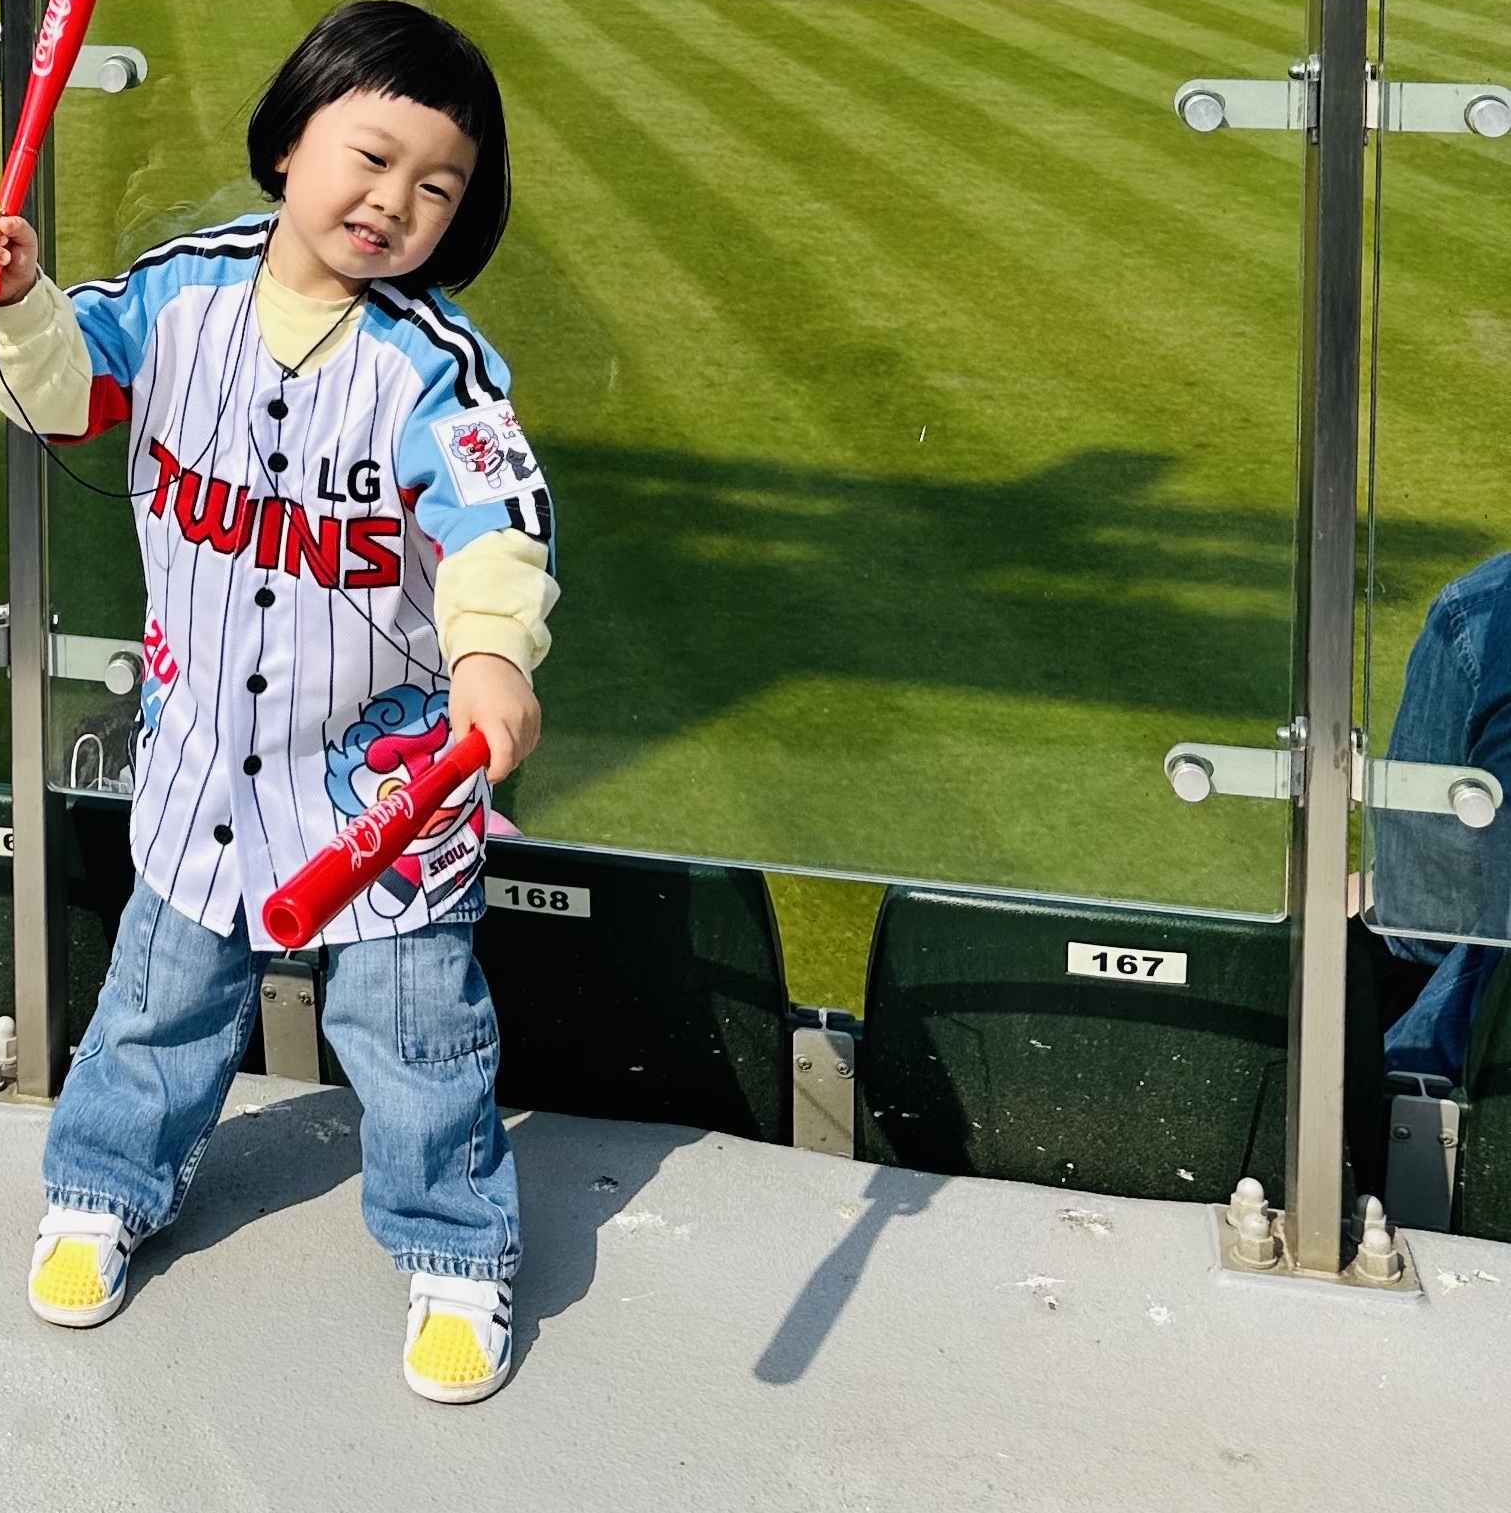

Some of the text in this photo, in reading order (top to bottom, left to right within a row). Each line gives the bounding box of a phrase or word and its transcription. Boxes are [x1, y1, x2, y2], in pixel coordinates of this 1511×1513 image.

[317, 457, 382, 504] LG
[149, 436, 403, 590] TWINS
[429, 842, 475, 878] SEOUL
[504, 885, 570, 911] 168
[1092, 951, 1164, 977] 167
